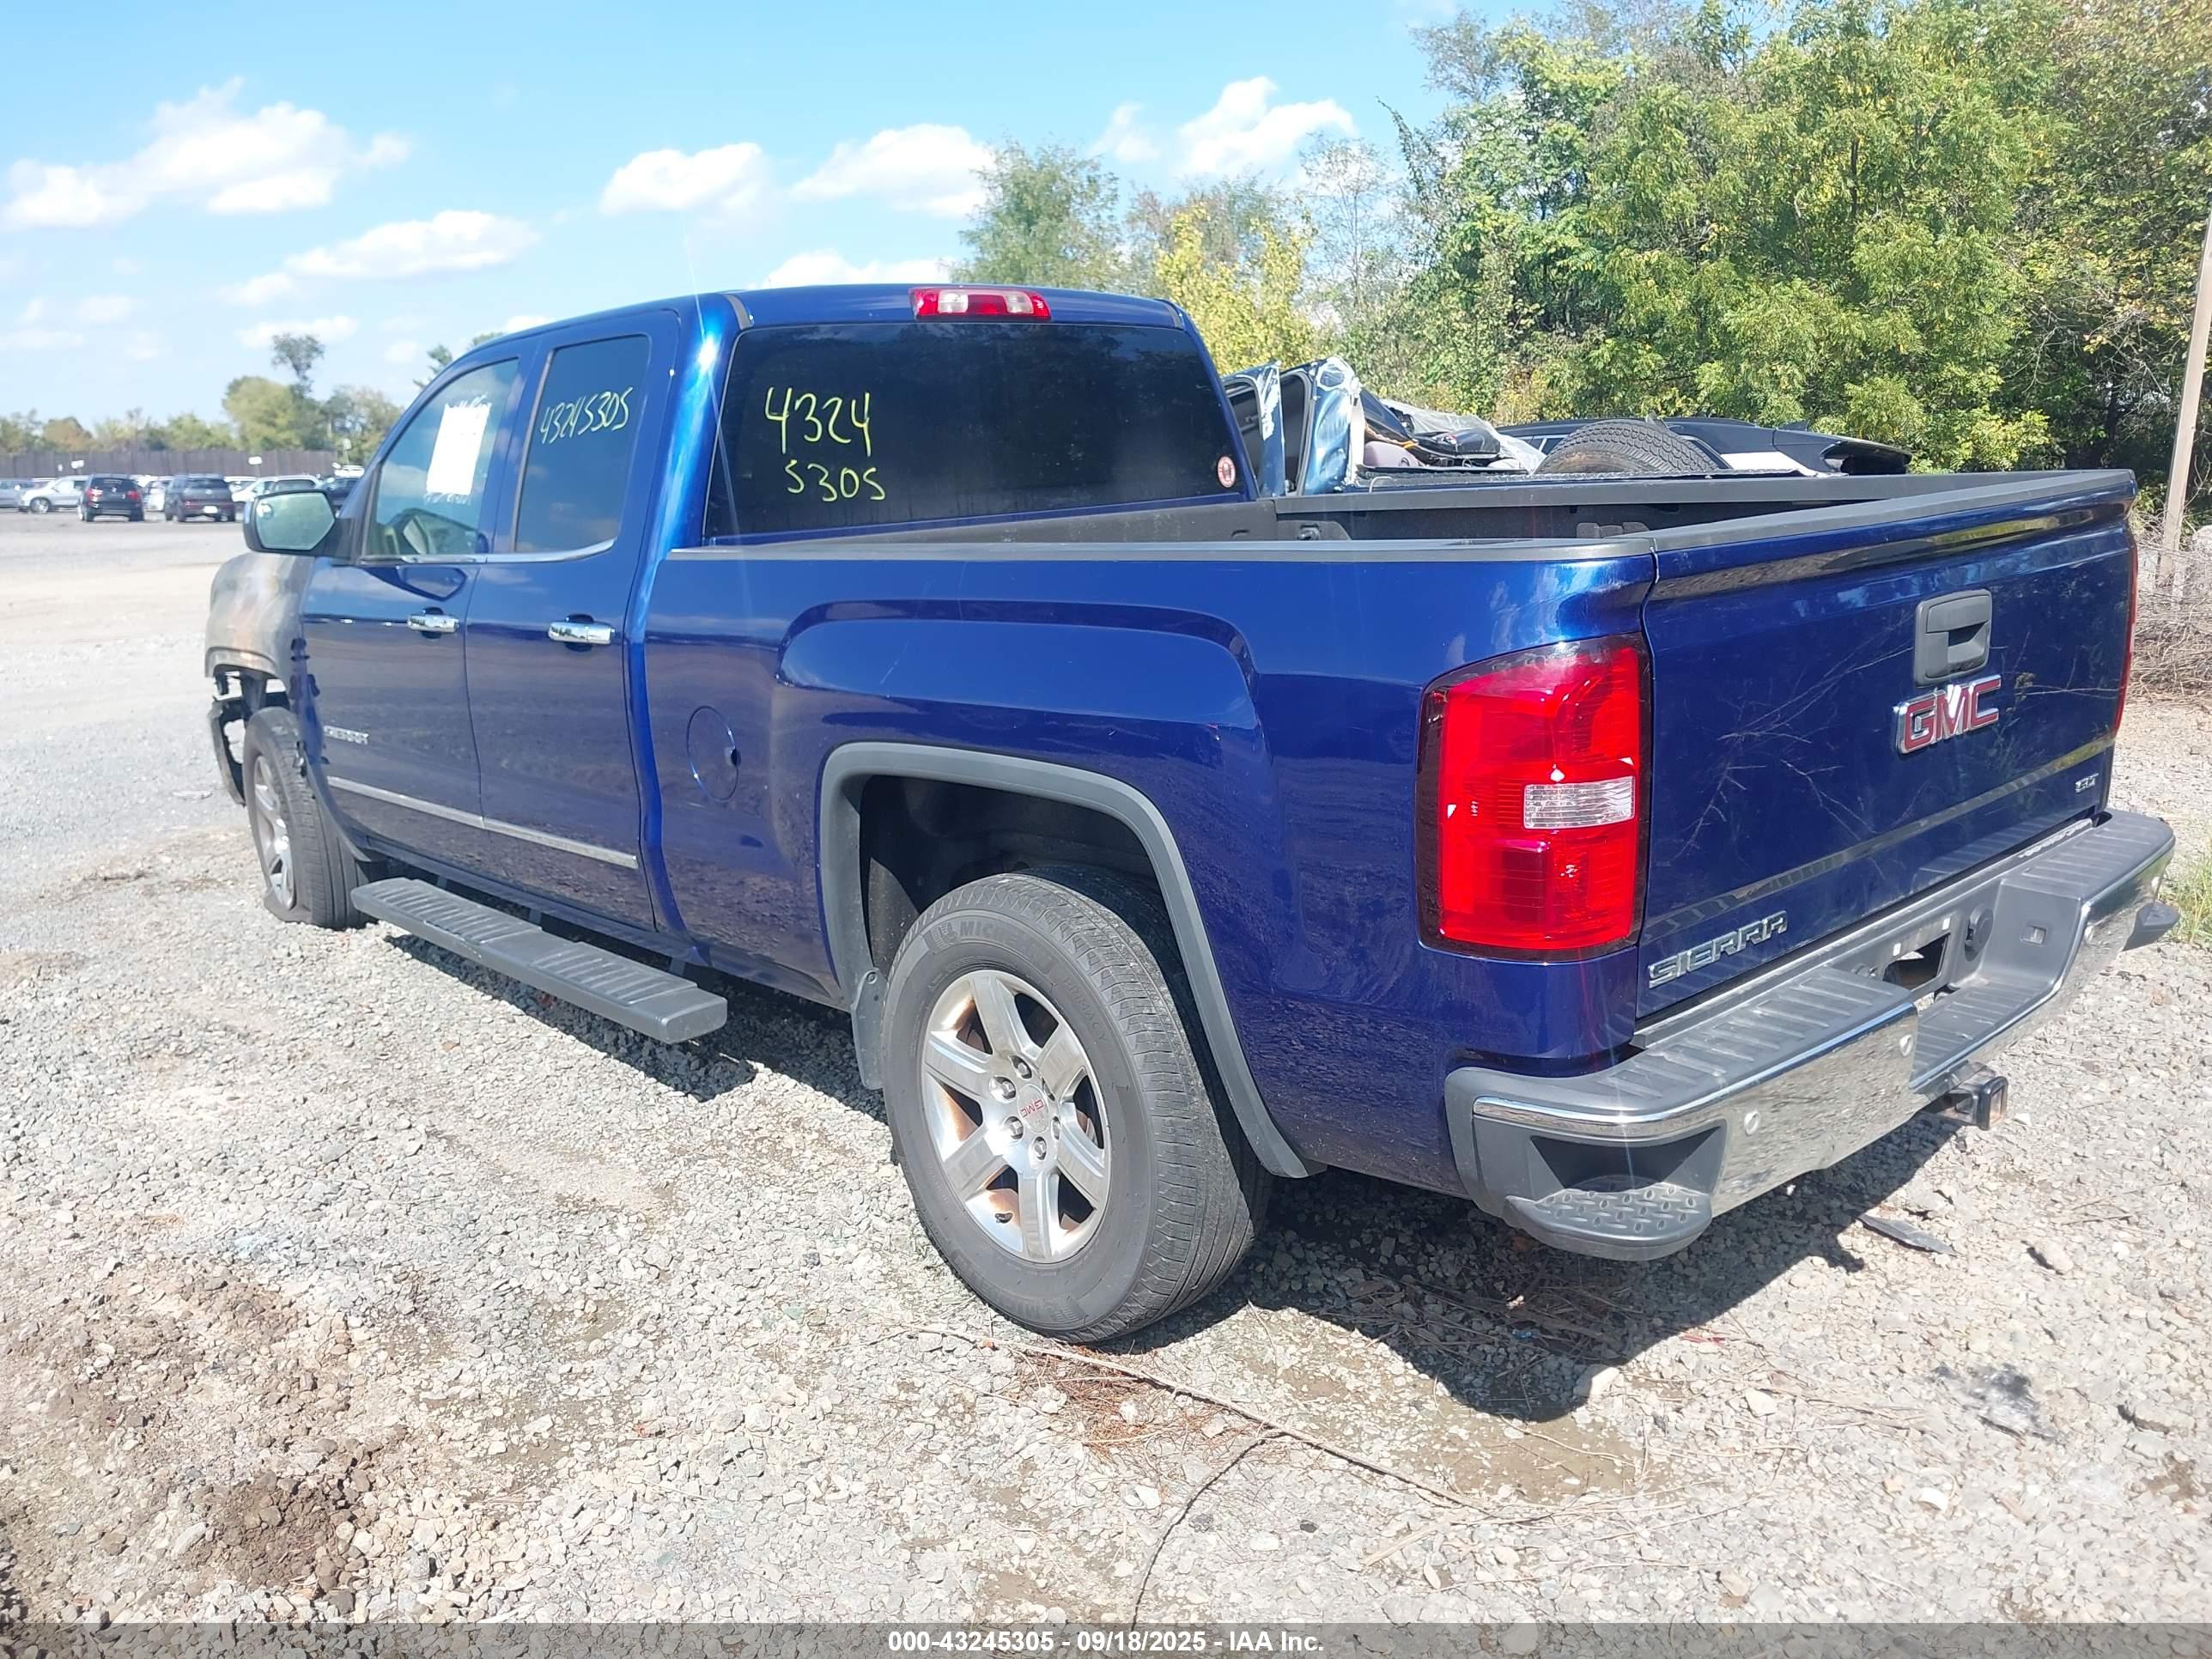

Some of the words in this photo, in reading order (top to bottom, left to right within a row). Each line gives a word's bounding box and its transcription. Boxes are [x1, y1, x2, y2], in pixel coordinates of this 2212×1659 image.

[540, 386, 634, 444] 43245305
[765, 386, 871, 457] 4324
[785, 459, 886, 501] 5305
[1894, 675, 2002, 754] GMC
[1648, 910, 1789, 989] SIERRA
[1020, 1098, 1044, 1118] GMC
